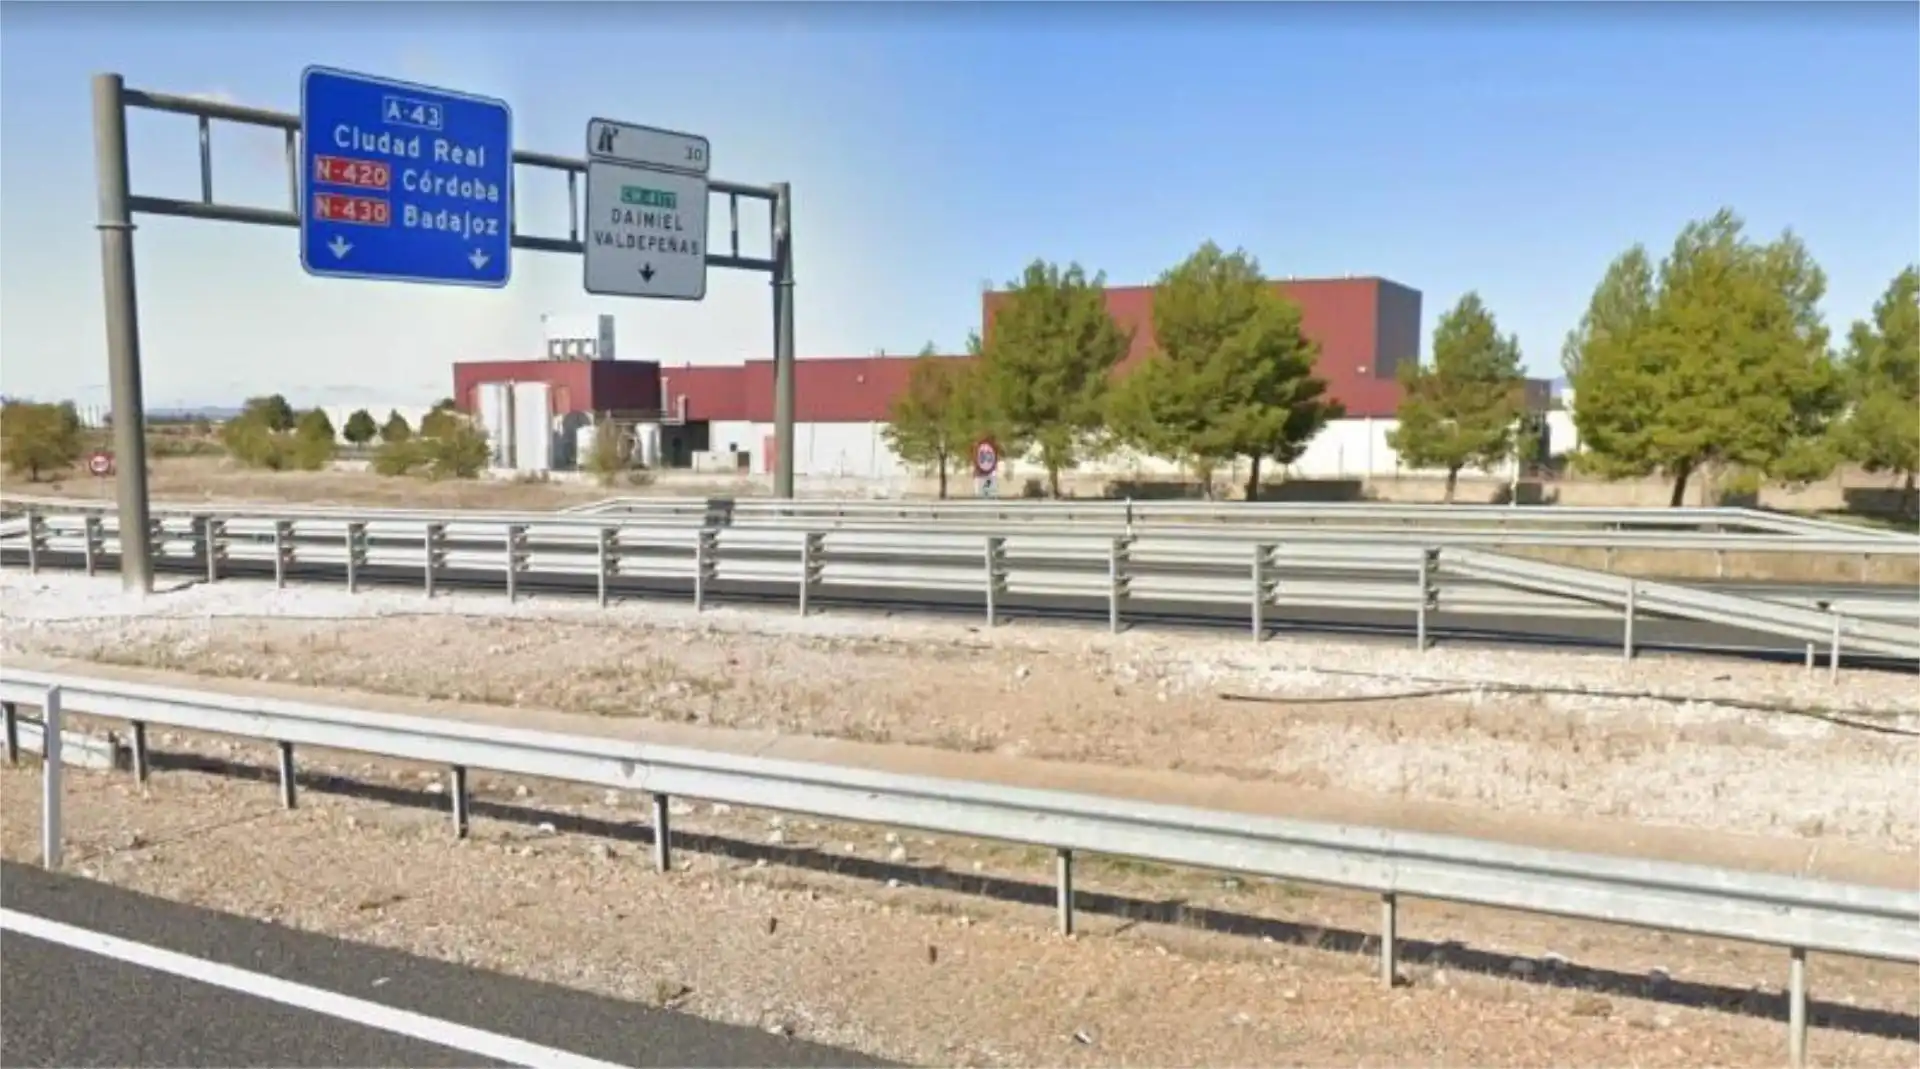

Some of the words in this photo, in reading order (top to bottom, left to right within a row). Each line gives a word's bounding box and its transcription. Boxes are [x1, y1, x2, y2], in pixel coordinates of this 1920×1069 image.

[387, 100, 440, 126] A-43
[334, 125, 420, 158] Ciudad
[434, 139, 485, 167] Real
[315, 158, 388, 186] N-420
[402, 169, 499, 202] Córdoba
[315, 196, 387, 223] N-430
[403, 204, 499, 240] Badajoz
[611, 208, 683, 231] DAIMIEL
[593, 230, 701, 255] VALDEPEÑAS
